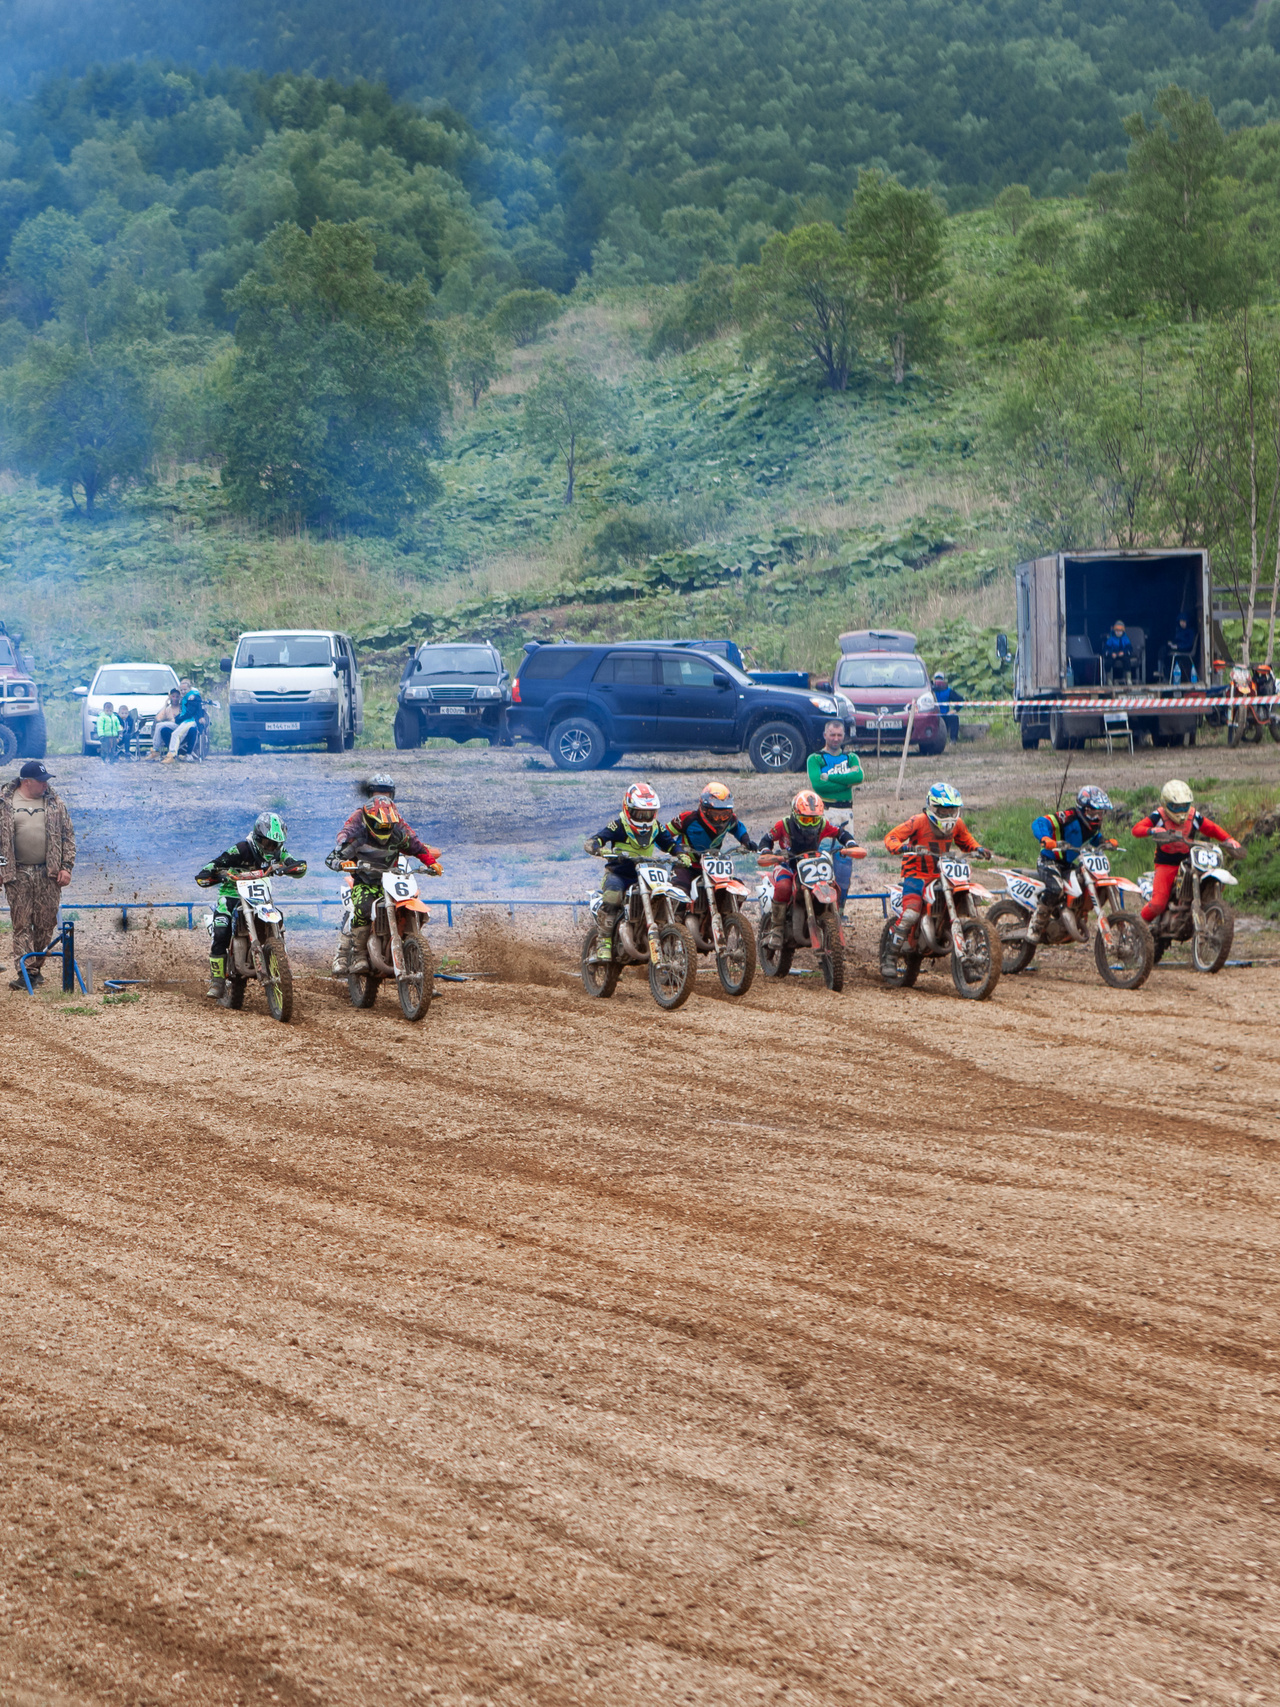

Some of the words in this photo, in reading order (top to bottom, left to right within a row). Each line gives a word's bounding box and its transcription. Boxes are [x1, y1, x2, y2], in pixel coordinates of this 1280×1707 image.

[706, 861, 733, 875] 203
[945, 864, 970, 879] 204
[1087, 857, 1109, 872] 206
[648, 869, 665, 883] 60
[802, 862, 833, 883] 29
[247, 884, 265, 898] 15
[394, 881, 410, 897] 6
[1011, 879, 1036, 899] 206
